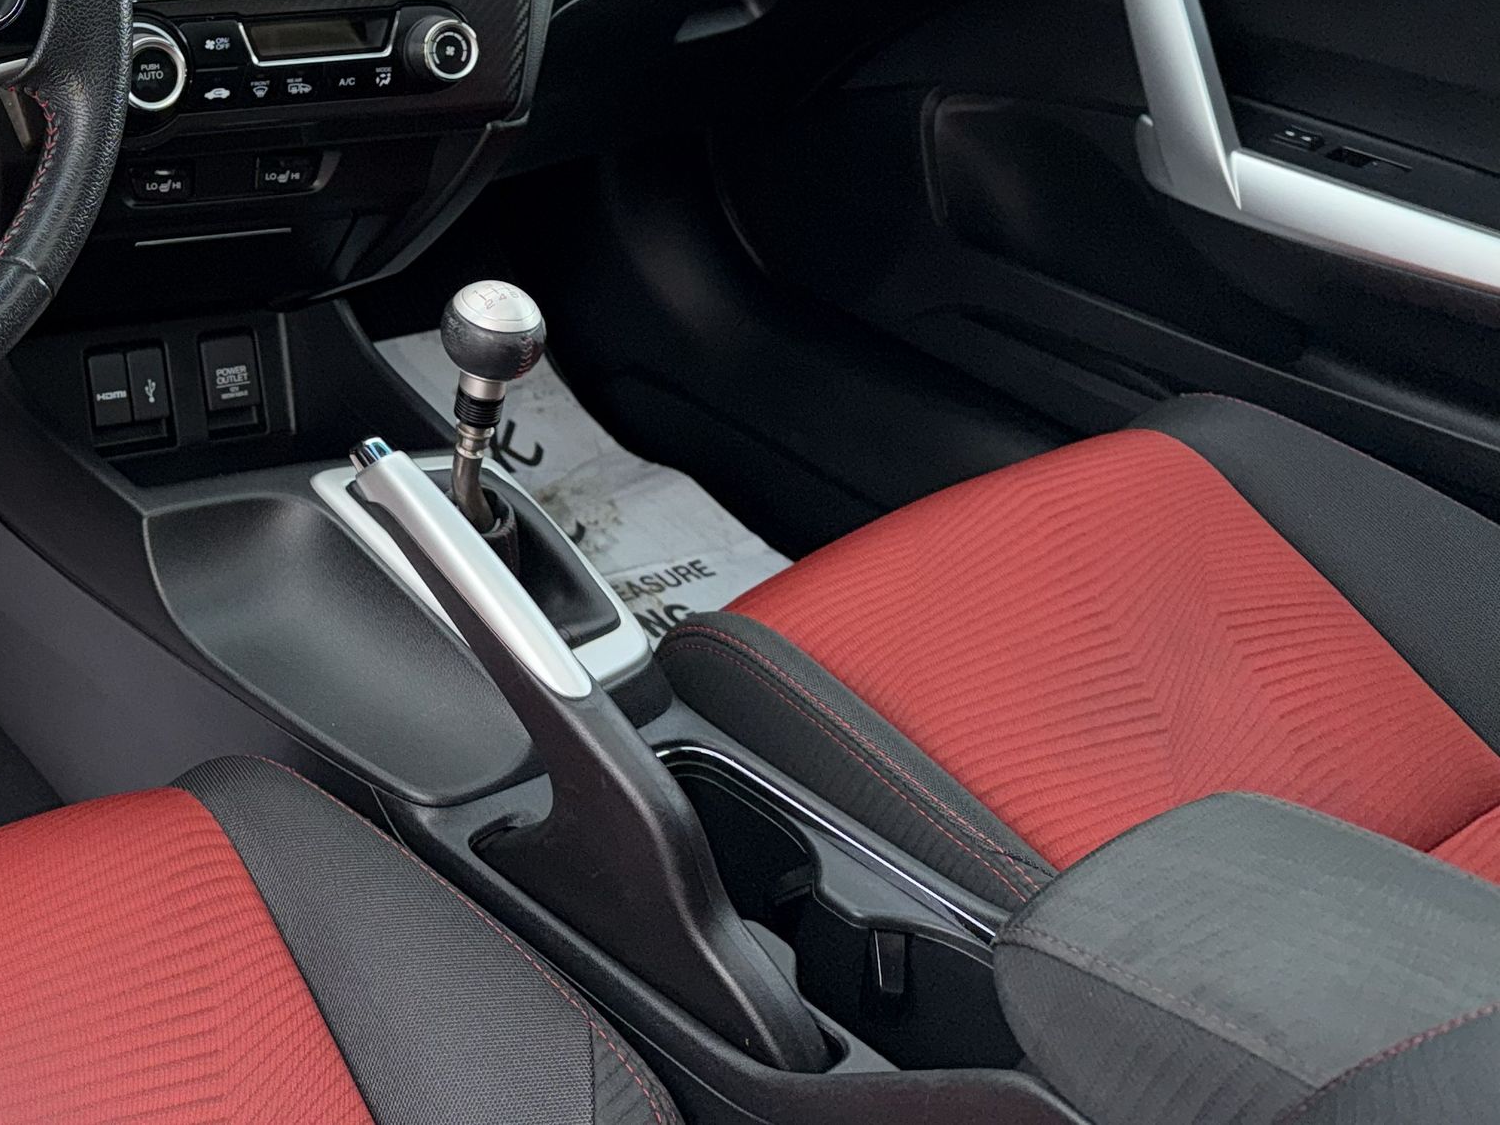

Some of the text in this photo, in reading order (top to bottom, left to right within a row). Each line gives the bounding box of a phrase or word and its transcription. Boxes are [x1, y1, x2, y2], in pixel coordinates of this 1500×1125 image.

[140, 63, 161, 71] PUSH
[137, 71, 164, 81] AUTO
[338, 77, 356, 87] A/C
[216, 365, 247, 377] POWER
[216, 373, 249, 385] OUTLET
[611, 559, 717, 602] EASURE
